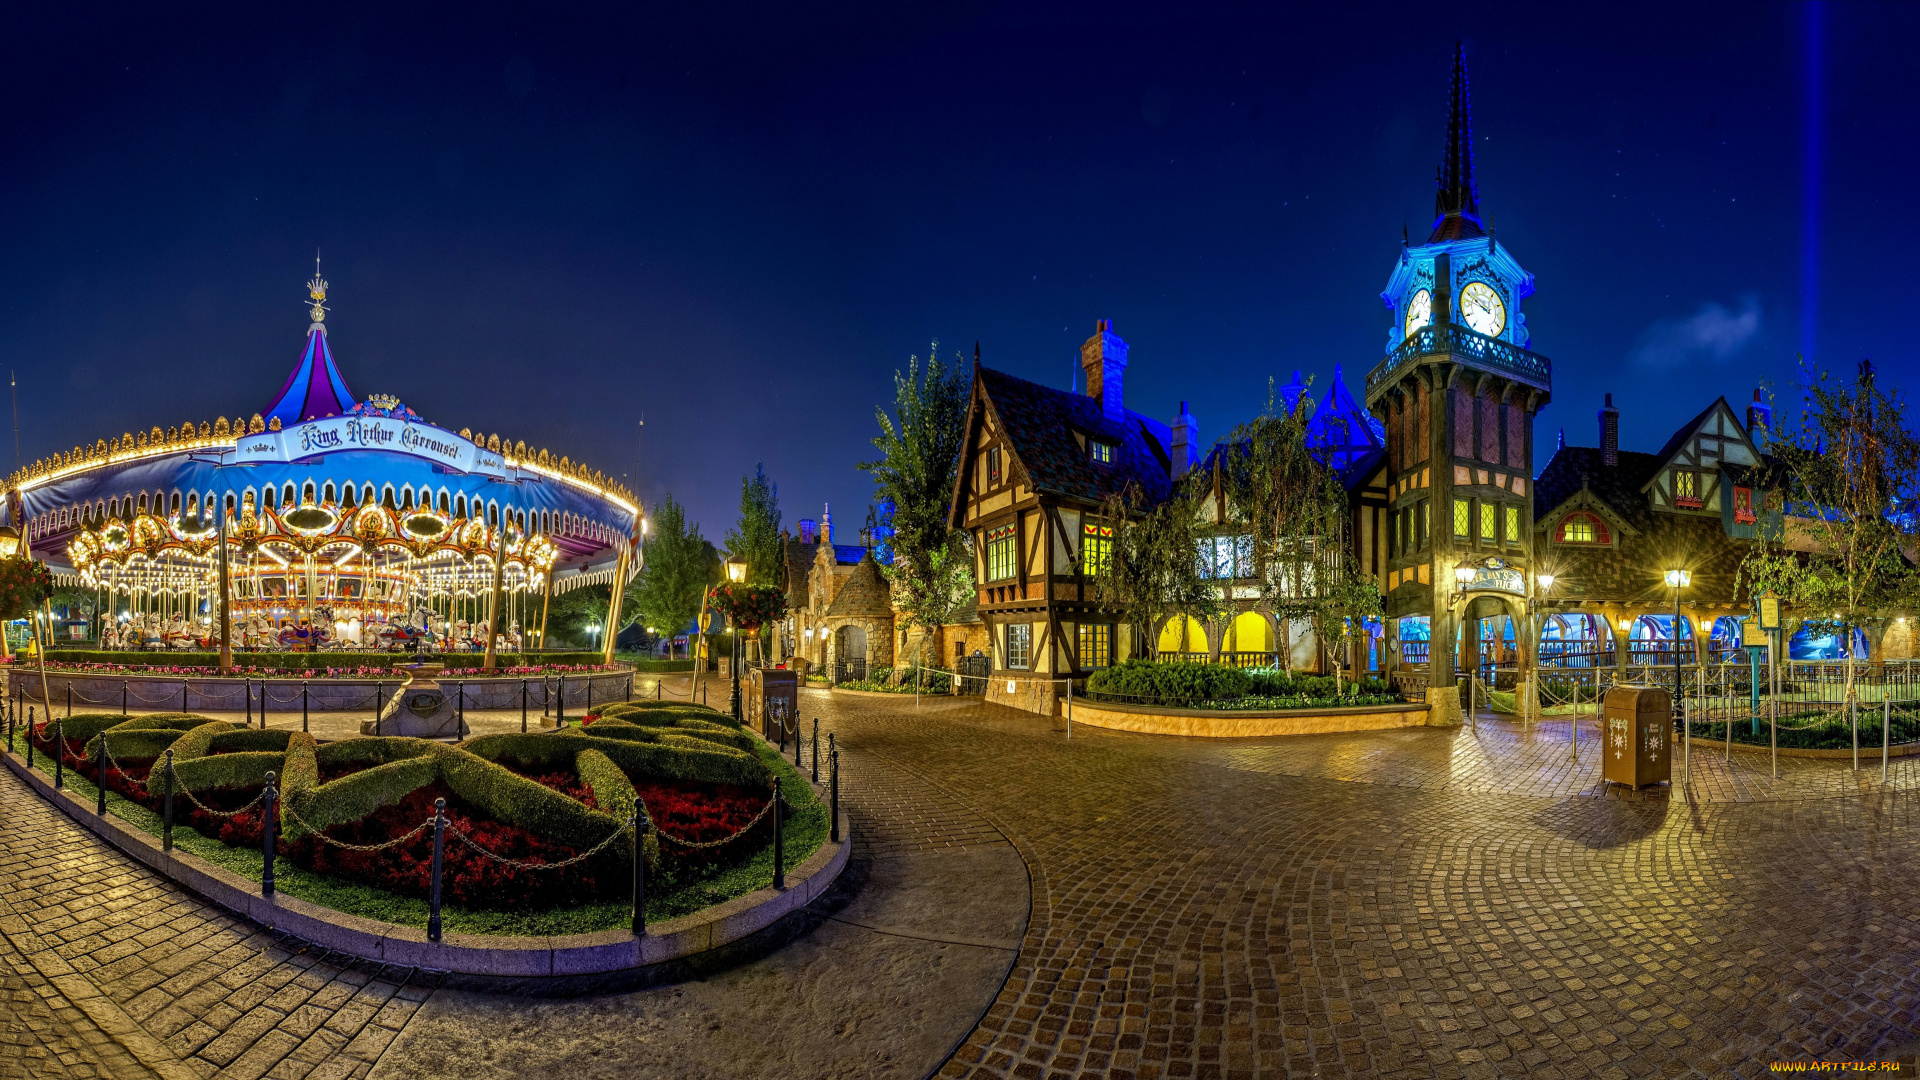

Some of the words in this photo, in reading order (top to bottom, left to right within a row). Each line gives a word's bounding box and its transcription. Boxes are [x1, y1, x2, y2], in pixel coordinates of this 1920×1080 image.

[297, 423, 342, 451] King
[346, 419, 394, 446] Arthur
[399, 424, 462, 459] Carrousel
